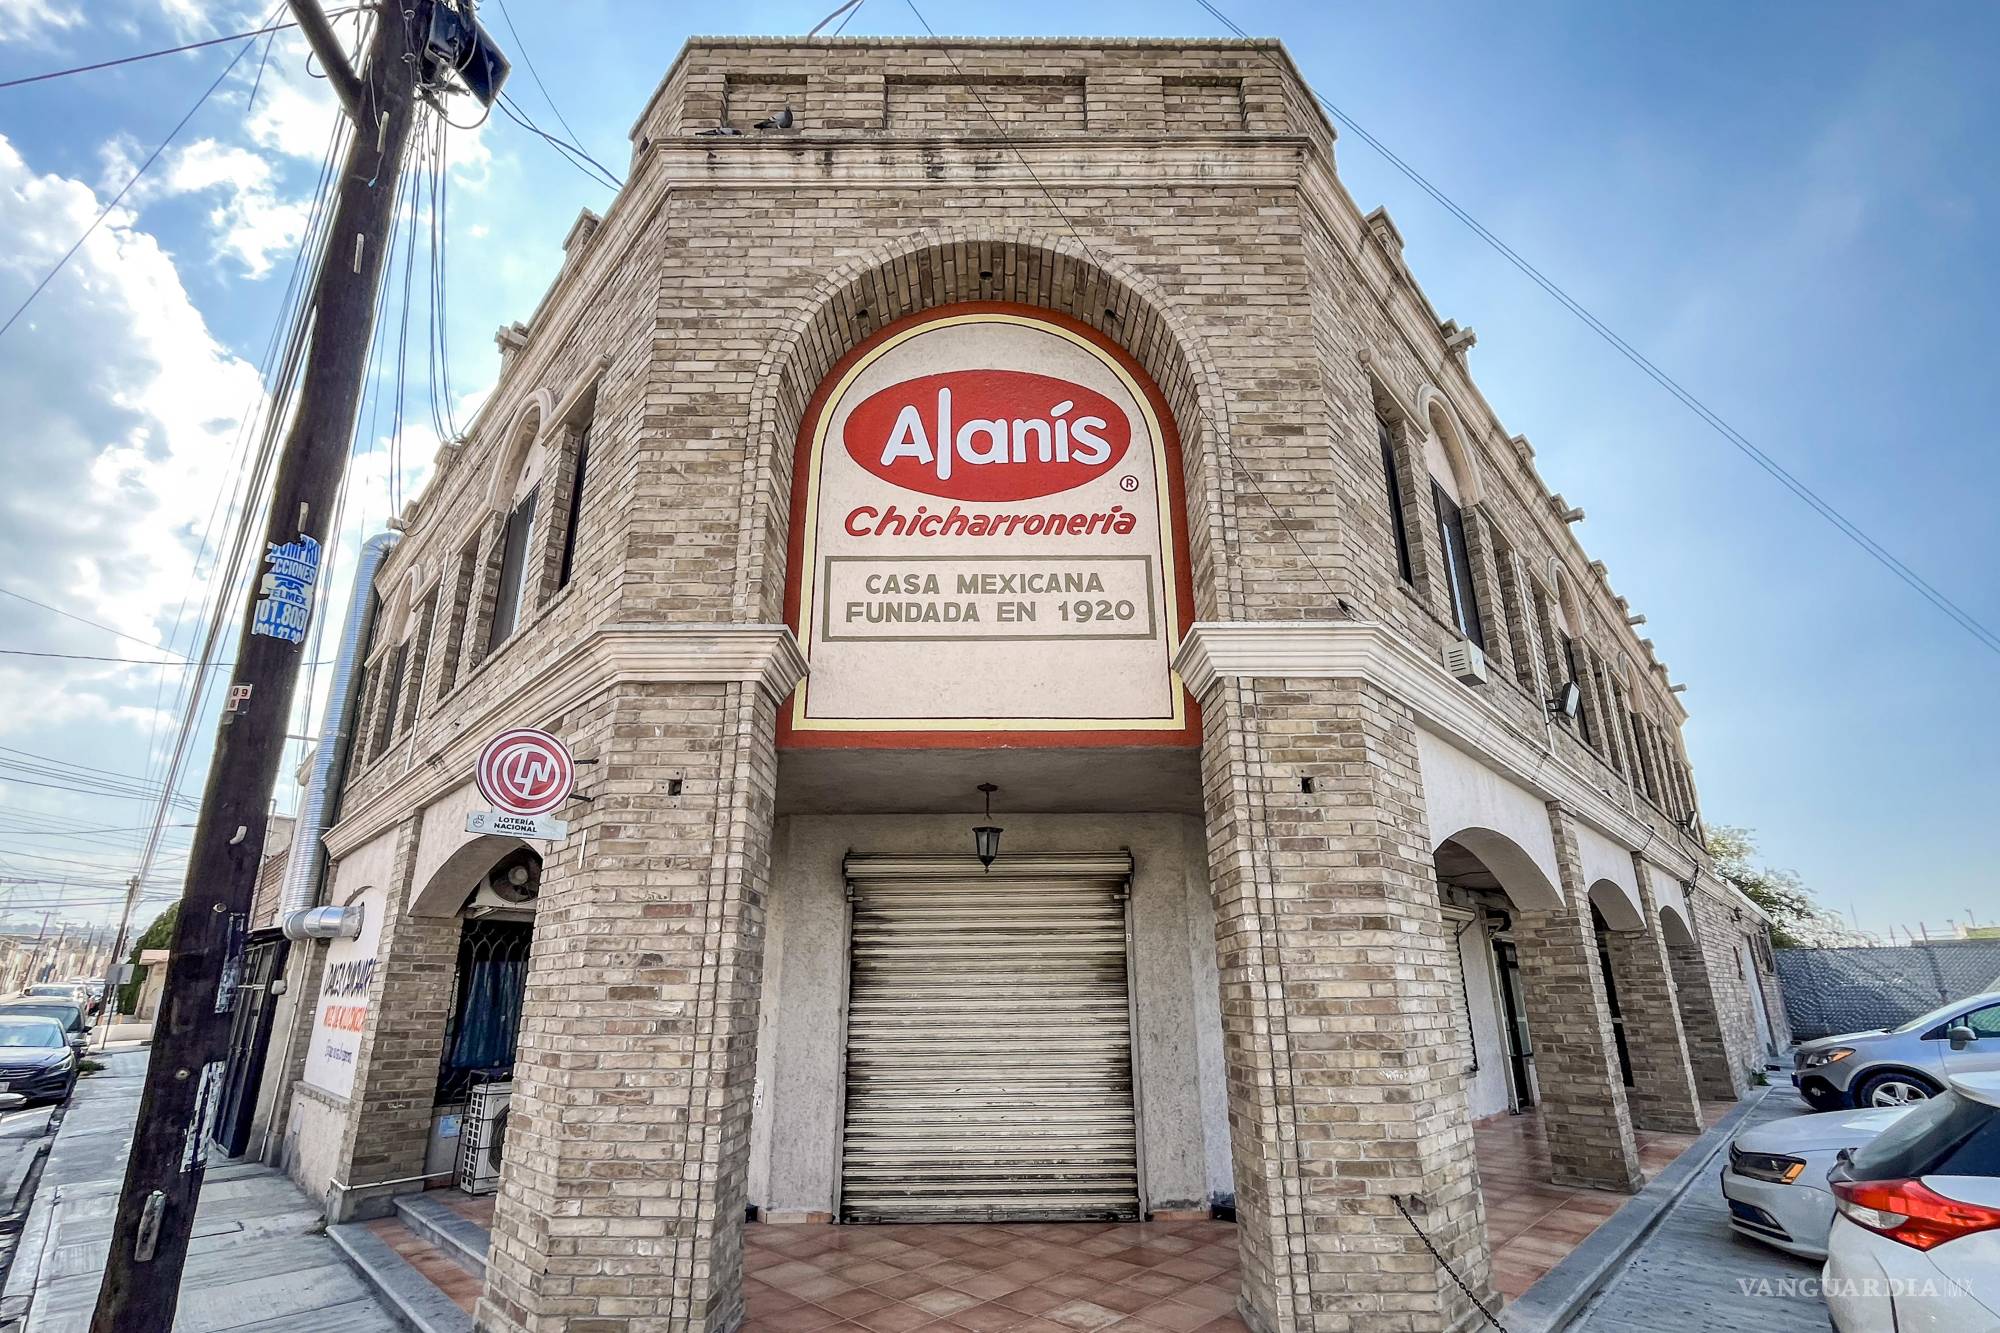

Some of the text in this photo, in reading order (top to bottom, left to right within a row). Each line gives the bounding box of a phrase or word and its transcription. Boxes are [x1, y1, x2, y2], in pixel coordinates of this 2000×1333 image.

[880, 387, 1112, 480] Alanís
[844, 505, 1137, 537] Chicharronería
[272, 559, 315, 583] CCIONES
[865, 572, 1105, 595] CASA MEXICANA
[845, 599, 1135, 623] FUNDADA EN 1920
[494, 822, 537, 833] NACIONAL
[498, 816, 535, 826] LOTERÍA
